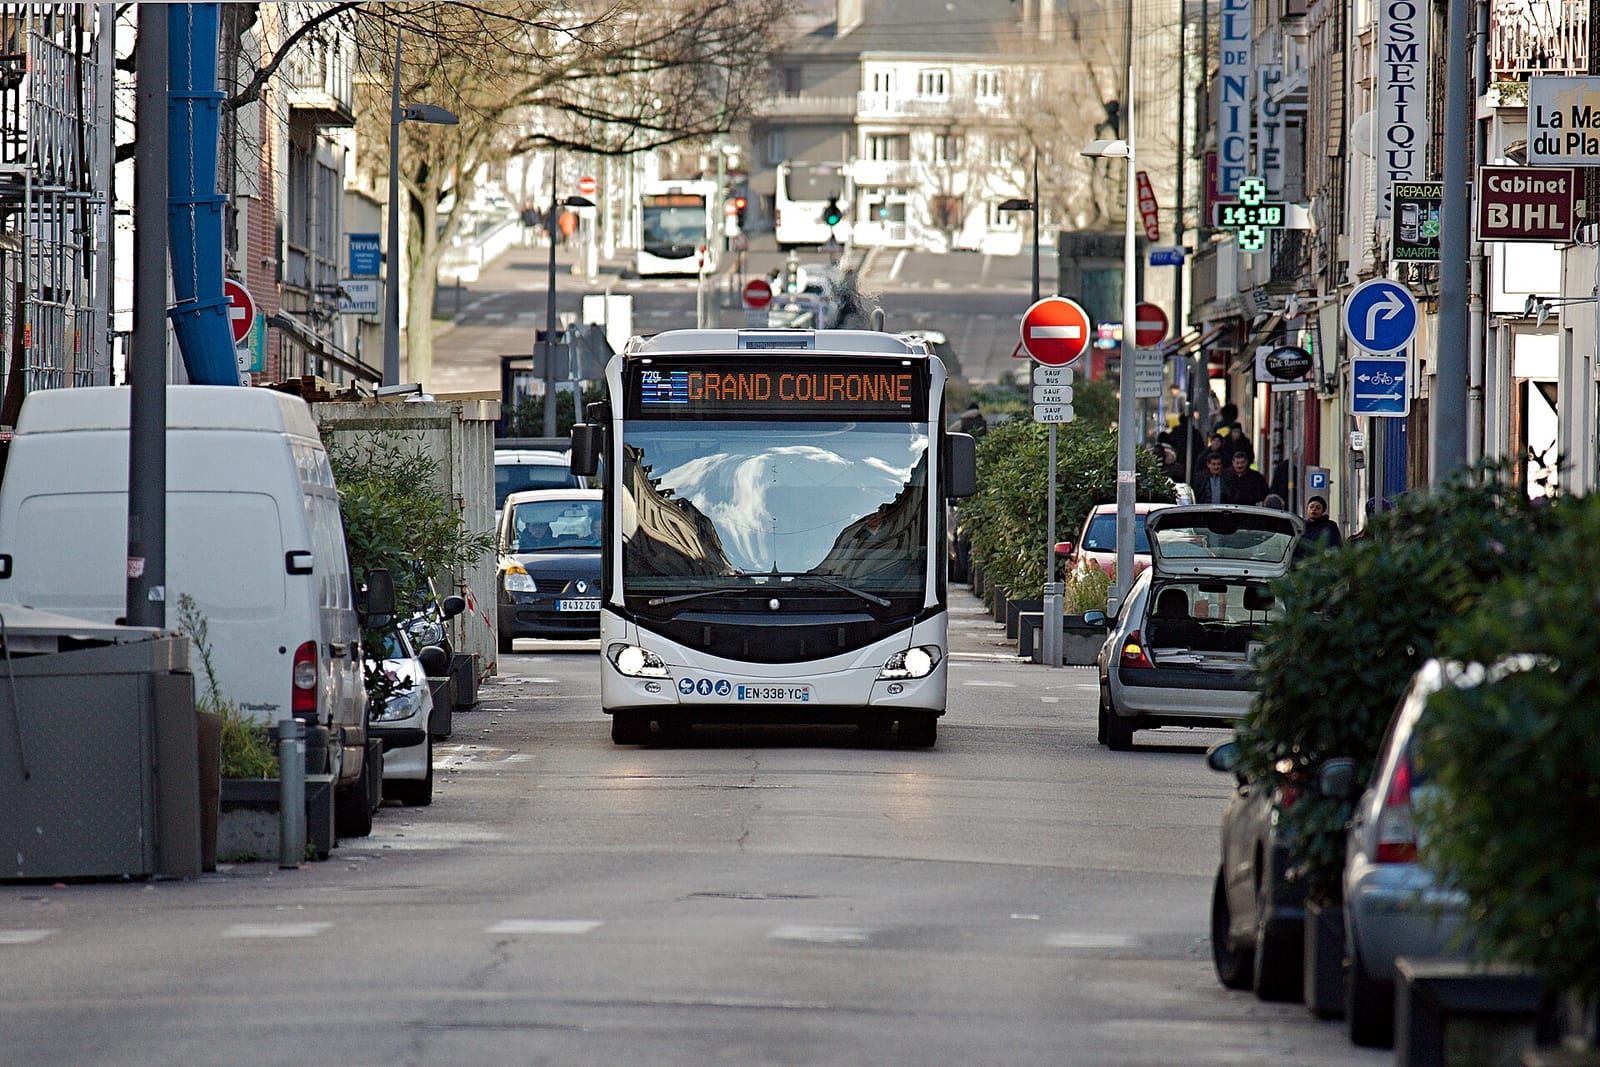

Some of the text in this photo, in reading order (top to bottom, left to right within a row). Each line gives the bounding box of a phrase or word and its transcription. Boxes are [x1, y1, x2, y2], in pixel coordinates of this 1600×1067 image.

[1224, 51, 1247, 65] DE
[1384, 0, 1419, 210] OSMETIQUE
[1536, 105, 1562, 129] La
[1222, 75, 1248, 193] NICE
[1533, 131, 1560, 155] du
[1488, 175, 1566, 194] Cabinet
[1487, 203, 1565, 232] BIHL
[687, 372, 912, 401] GRAND COURONNE
[562, 601, 584, 610] 8432
[745, 687, 802, 700] EN-338-YC
